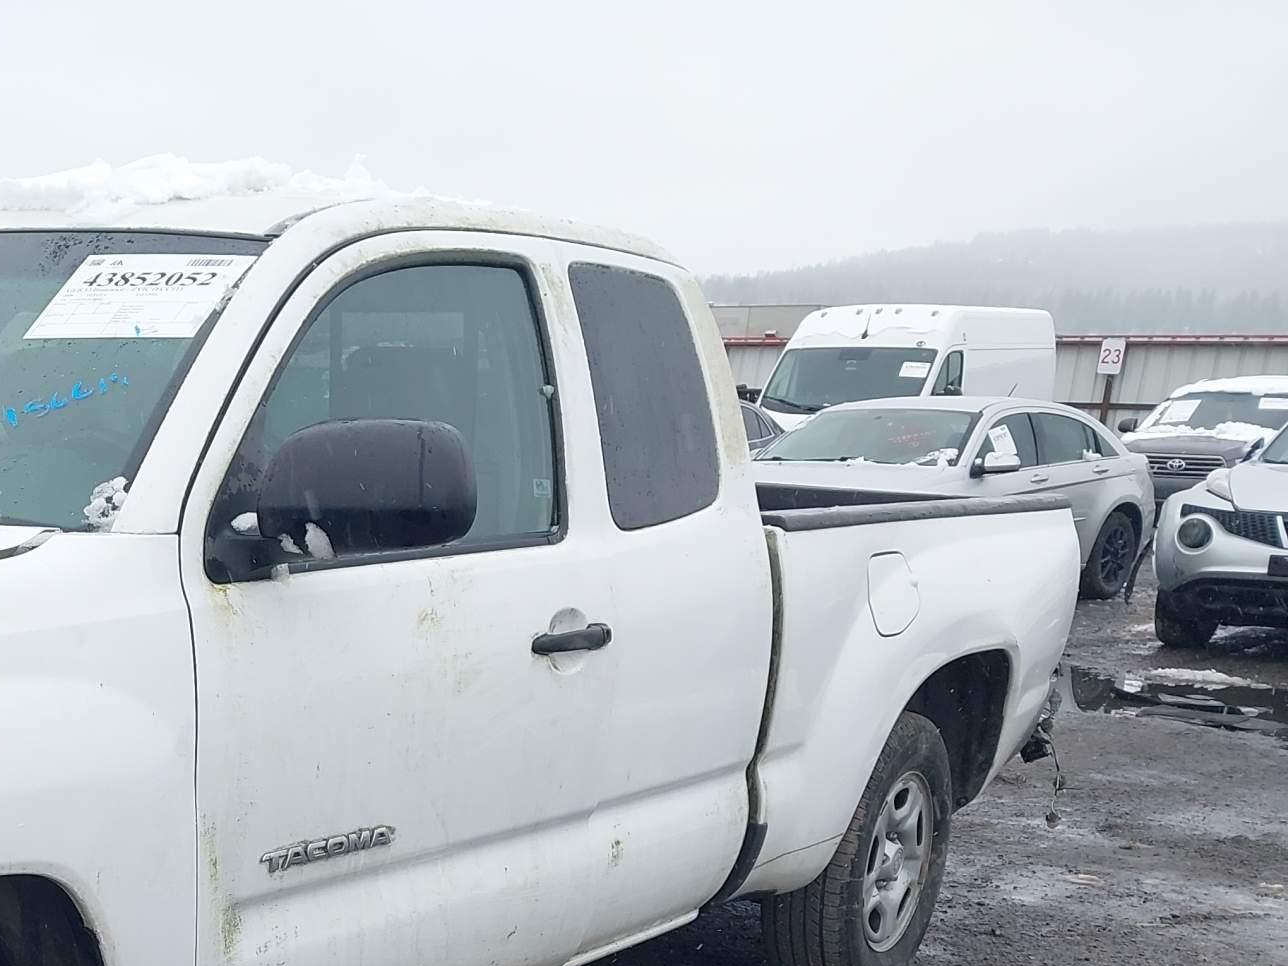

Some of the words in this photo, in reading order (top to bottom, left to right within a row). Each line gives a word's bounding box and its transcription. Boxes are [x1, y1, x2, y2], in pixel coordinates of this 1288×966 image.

[82, 271, 218, 288] 43852052
[1101, 348, 1122, 365] 23
[259, 825, 395, 873] TACOMA
